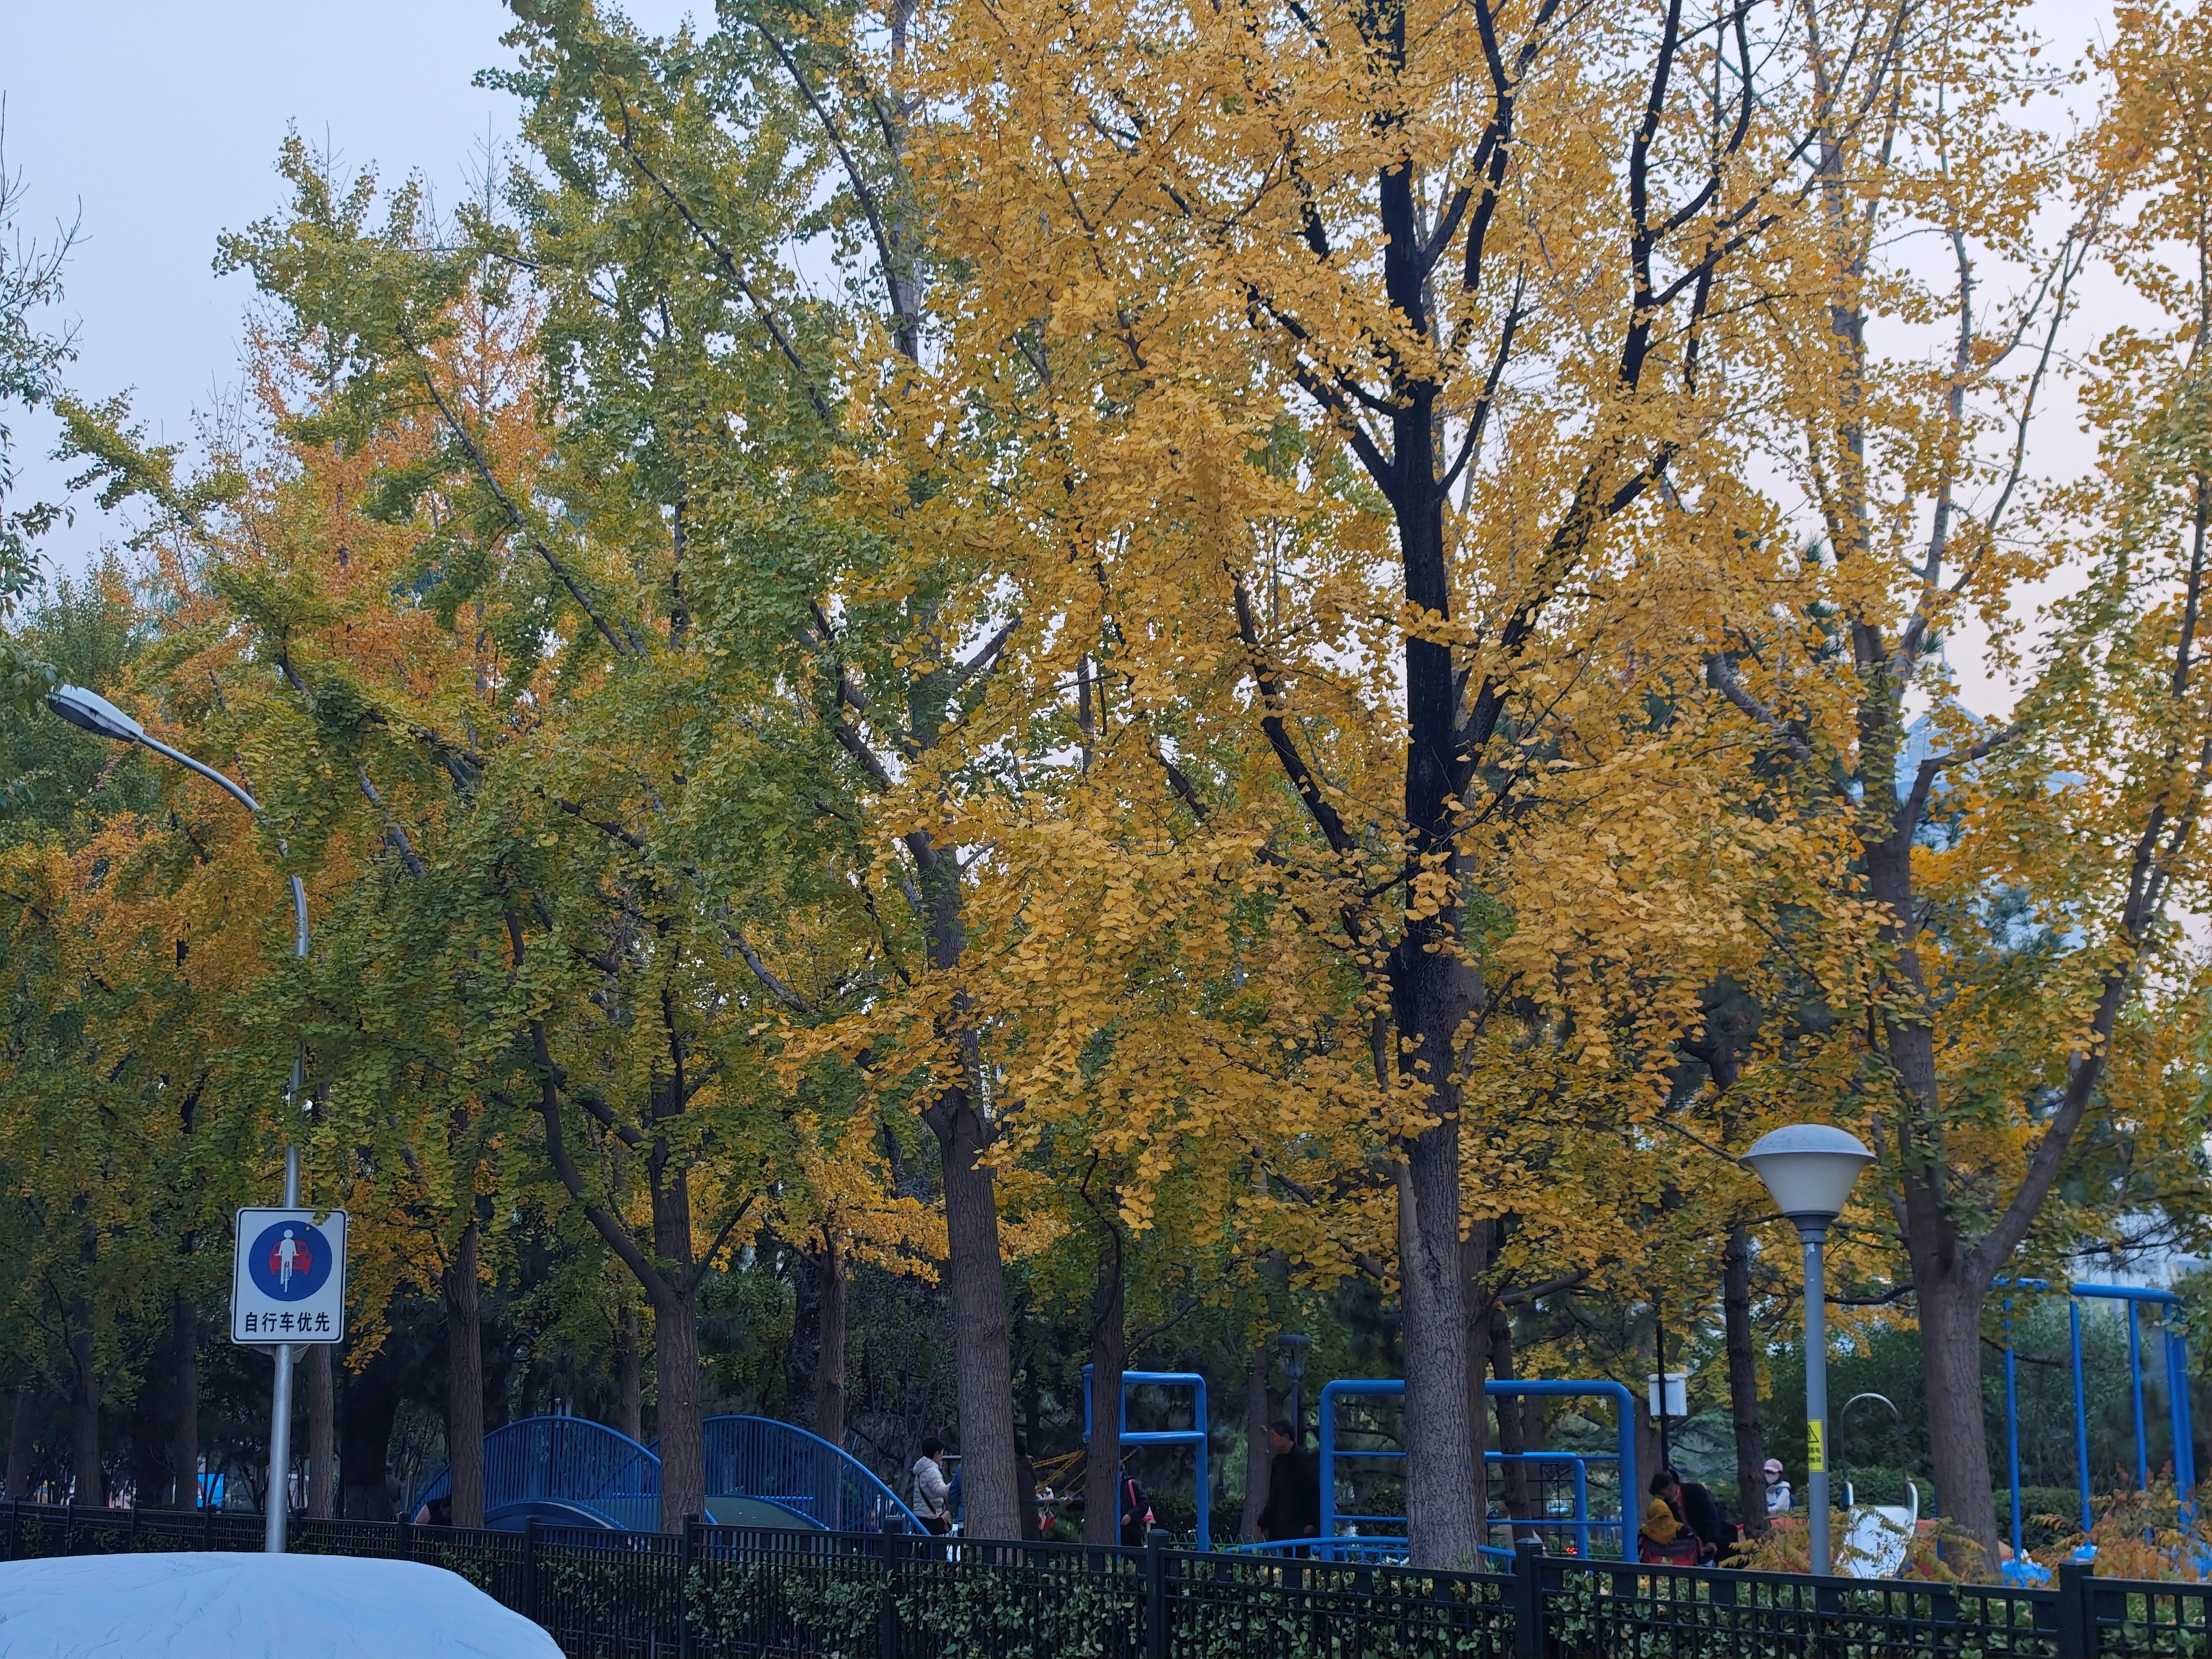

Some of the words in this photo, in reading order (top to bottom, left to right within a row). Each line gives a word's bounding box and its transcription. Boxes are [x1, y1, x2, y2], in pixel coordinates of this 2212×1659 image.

[245, 1311, 330, 1333] 自行车优先
